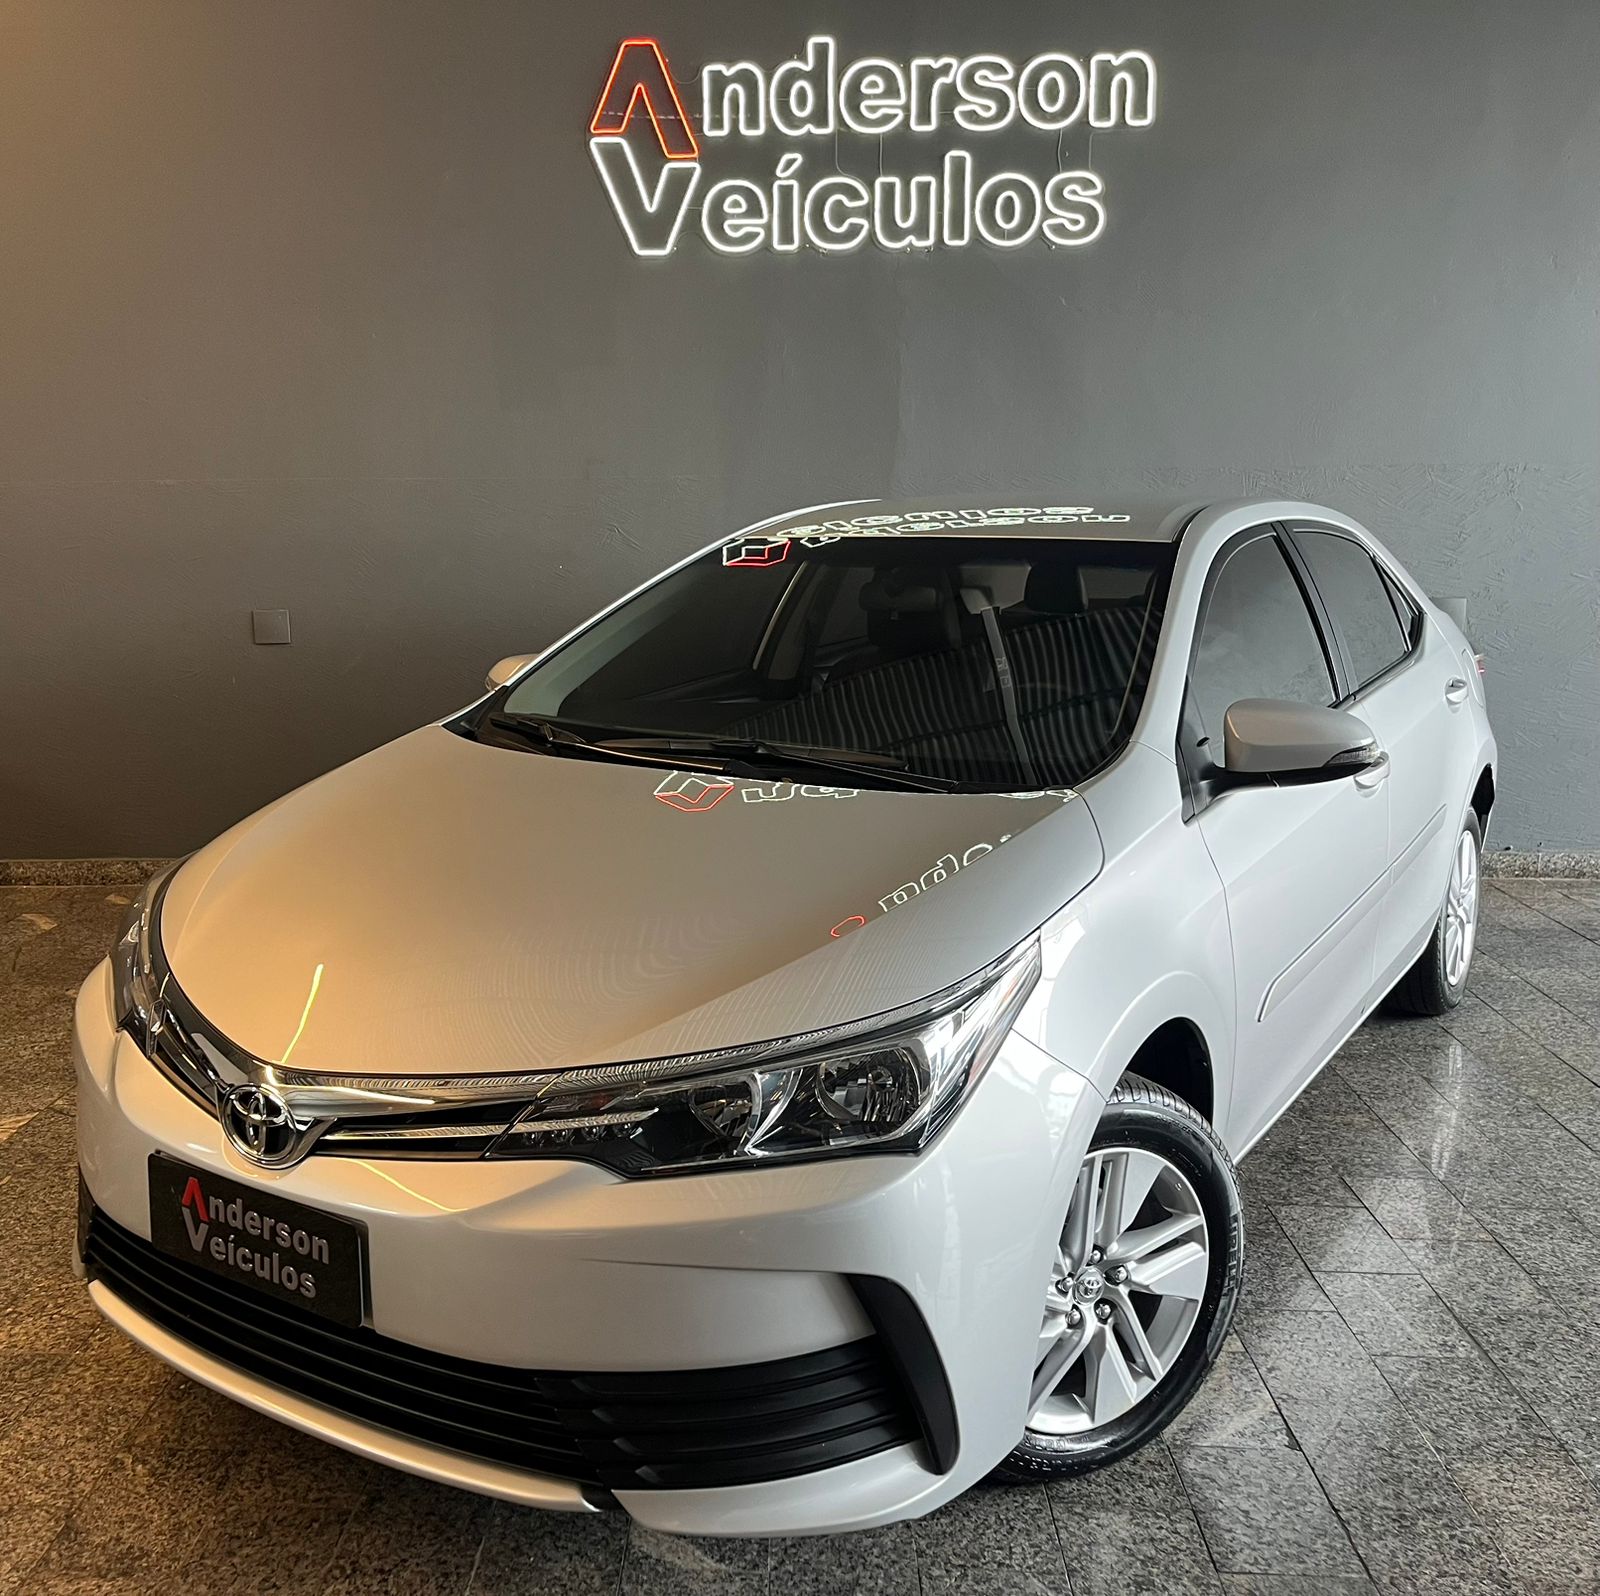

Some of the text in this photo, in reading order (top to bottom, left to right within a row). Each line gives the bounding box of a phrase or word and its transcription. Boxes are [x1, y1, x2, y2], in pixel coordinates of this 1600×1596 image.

[589, 36, 1157, 158] Anderson
[589, 137, 1105, 256] Veículos
[181, 1177, 329, 1265] Anderson
[181, 1206, 317, 1299] Veículos
